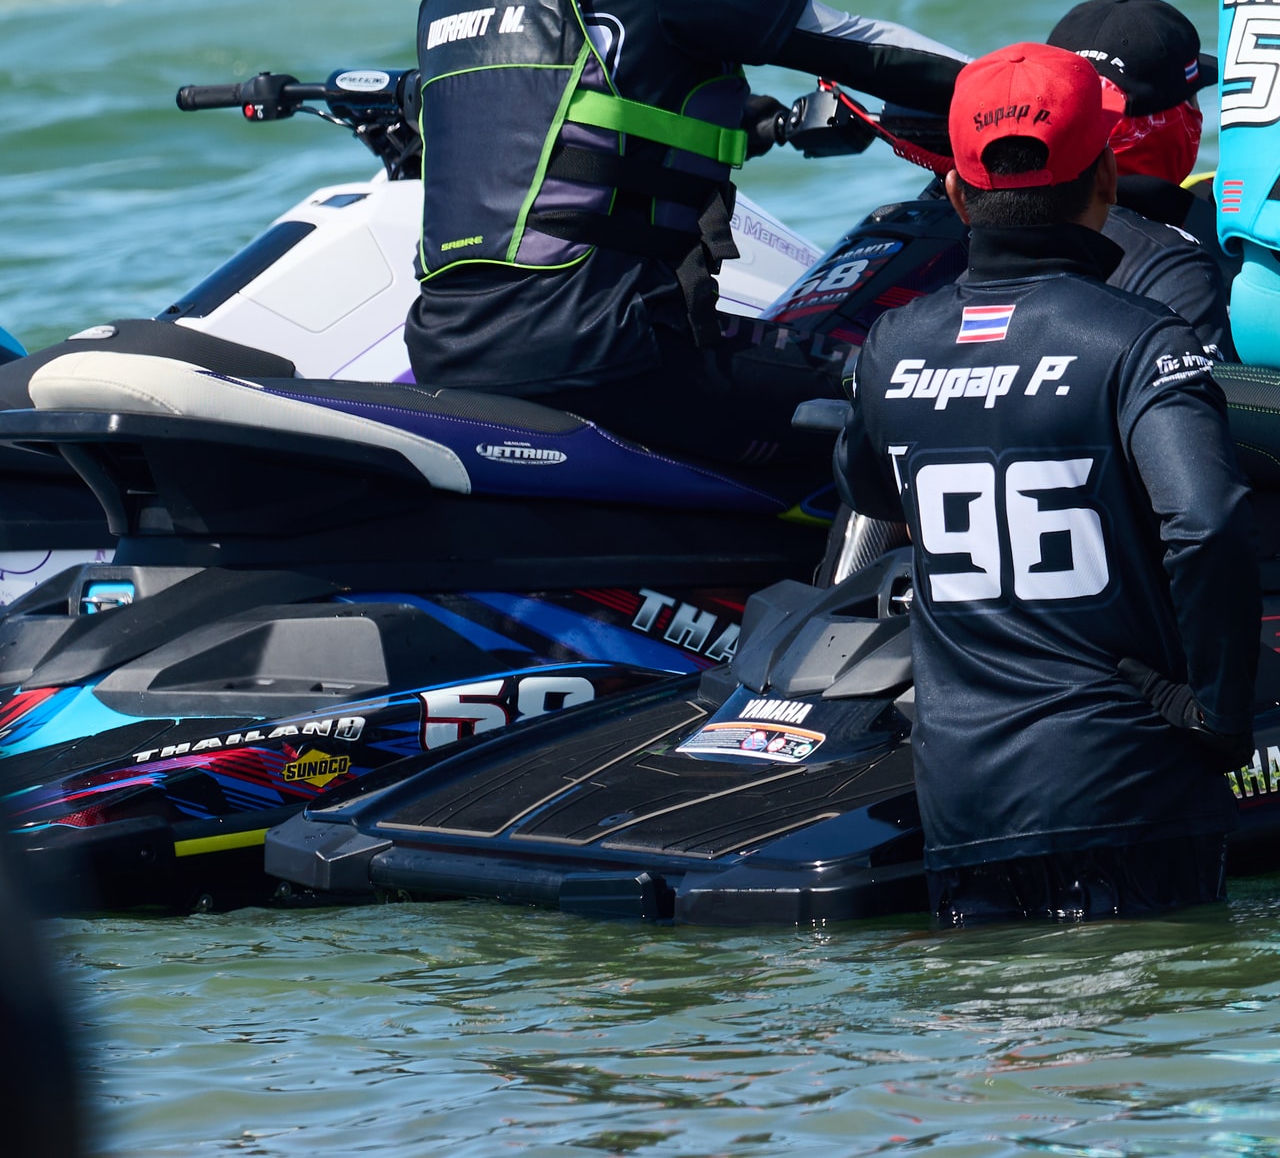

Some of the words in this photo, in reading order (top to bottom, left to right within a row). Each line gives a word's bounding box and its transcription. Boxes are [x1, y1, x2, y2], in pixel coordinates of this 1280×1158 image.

[426, 8, 497, 51] WORAKIT
[498, 5, 525, 35] M.
[973, 102, 1030, 134] Supap
[441, 234, 484, 252] SABRE
[884, 358, 1020, 410] Supap
[1024, 355, 1078, 396] P.
[481, 444, 562, 461] JETTRIM
[915, 458, 1110, 602] 96
[738, 699, 813, 724] YAMAHA
[133, 715, 366, 763] THAILAND
[286, 757, 349, 781] SUNOCO
